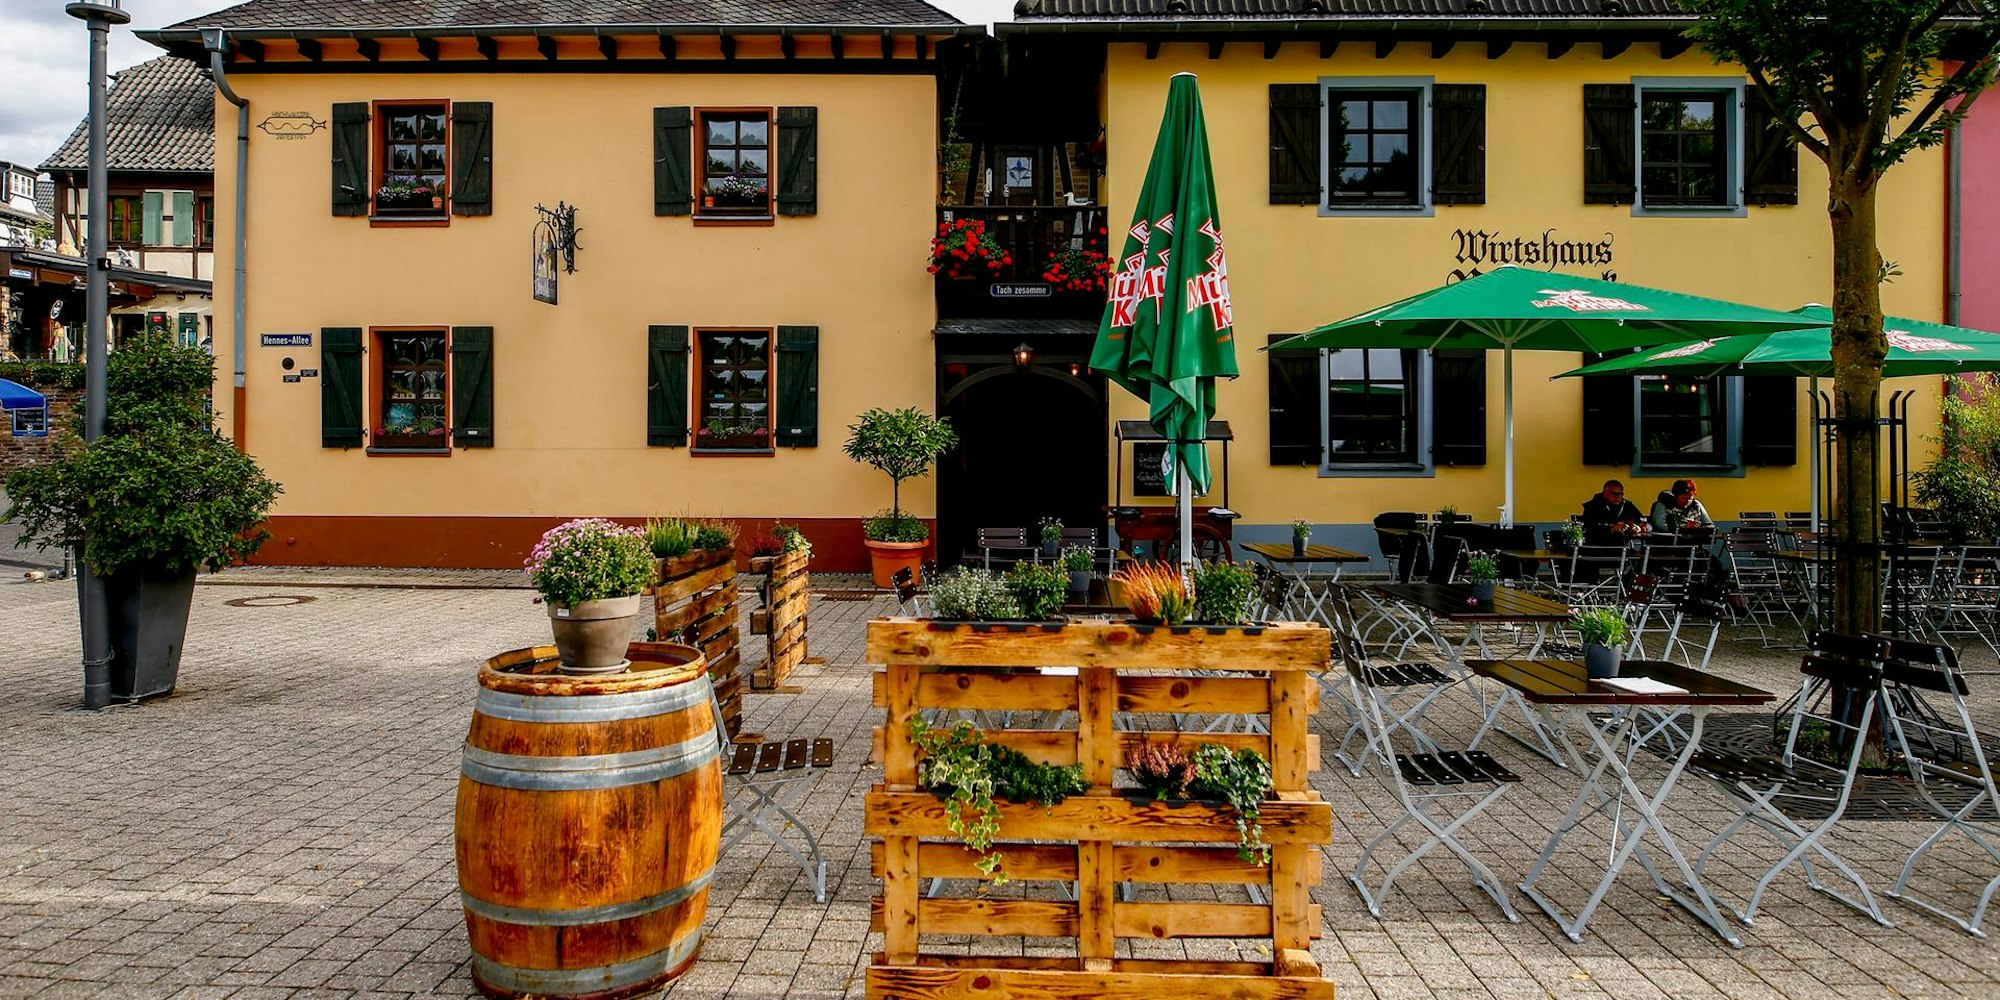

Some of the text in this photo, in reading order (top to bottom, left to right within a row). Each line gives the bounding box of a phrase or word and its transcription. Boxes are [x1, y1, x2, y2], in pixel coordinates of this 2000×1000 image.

[1451, 228, 1615, 272] Wirtshaus
[996, 285, 1047, 295] Tach zesamme
[263, 335, 310, 345] Hennes-Allee
